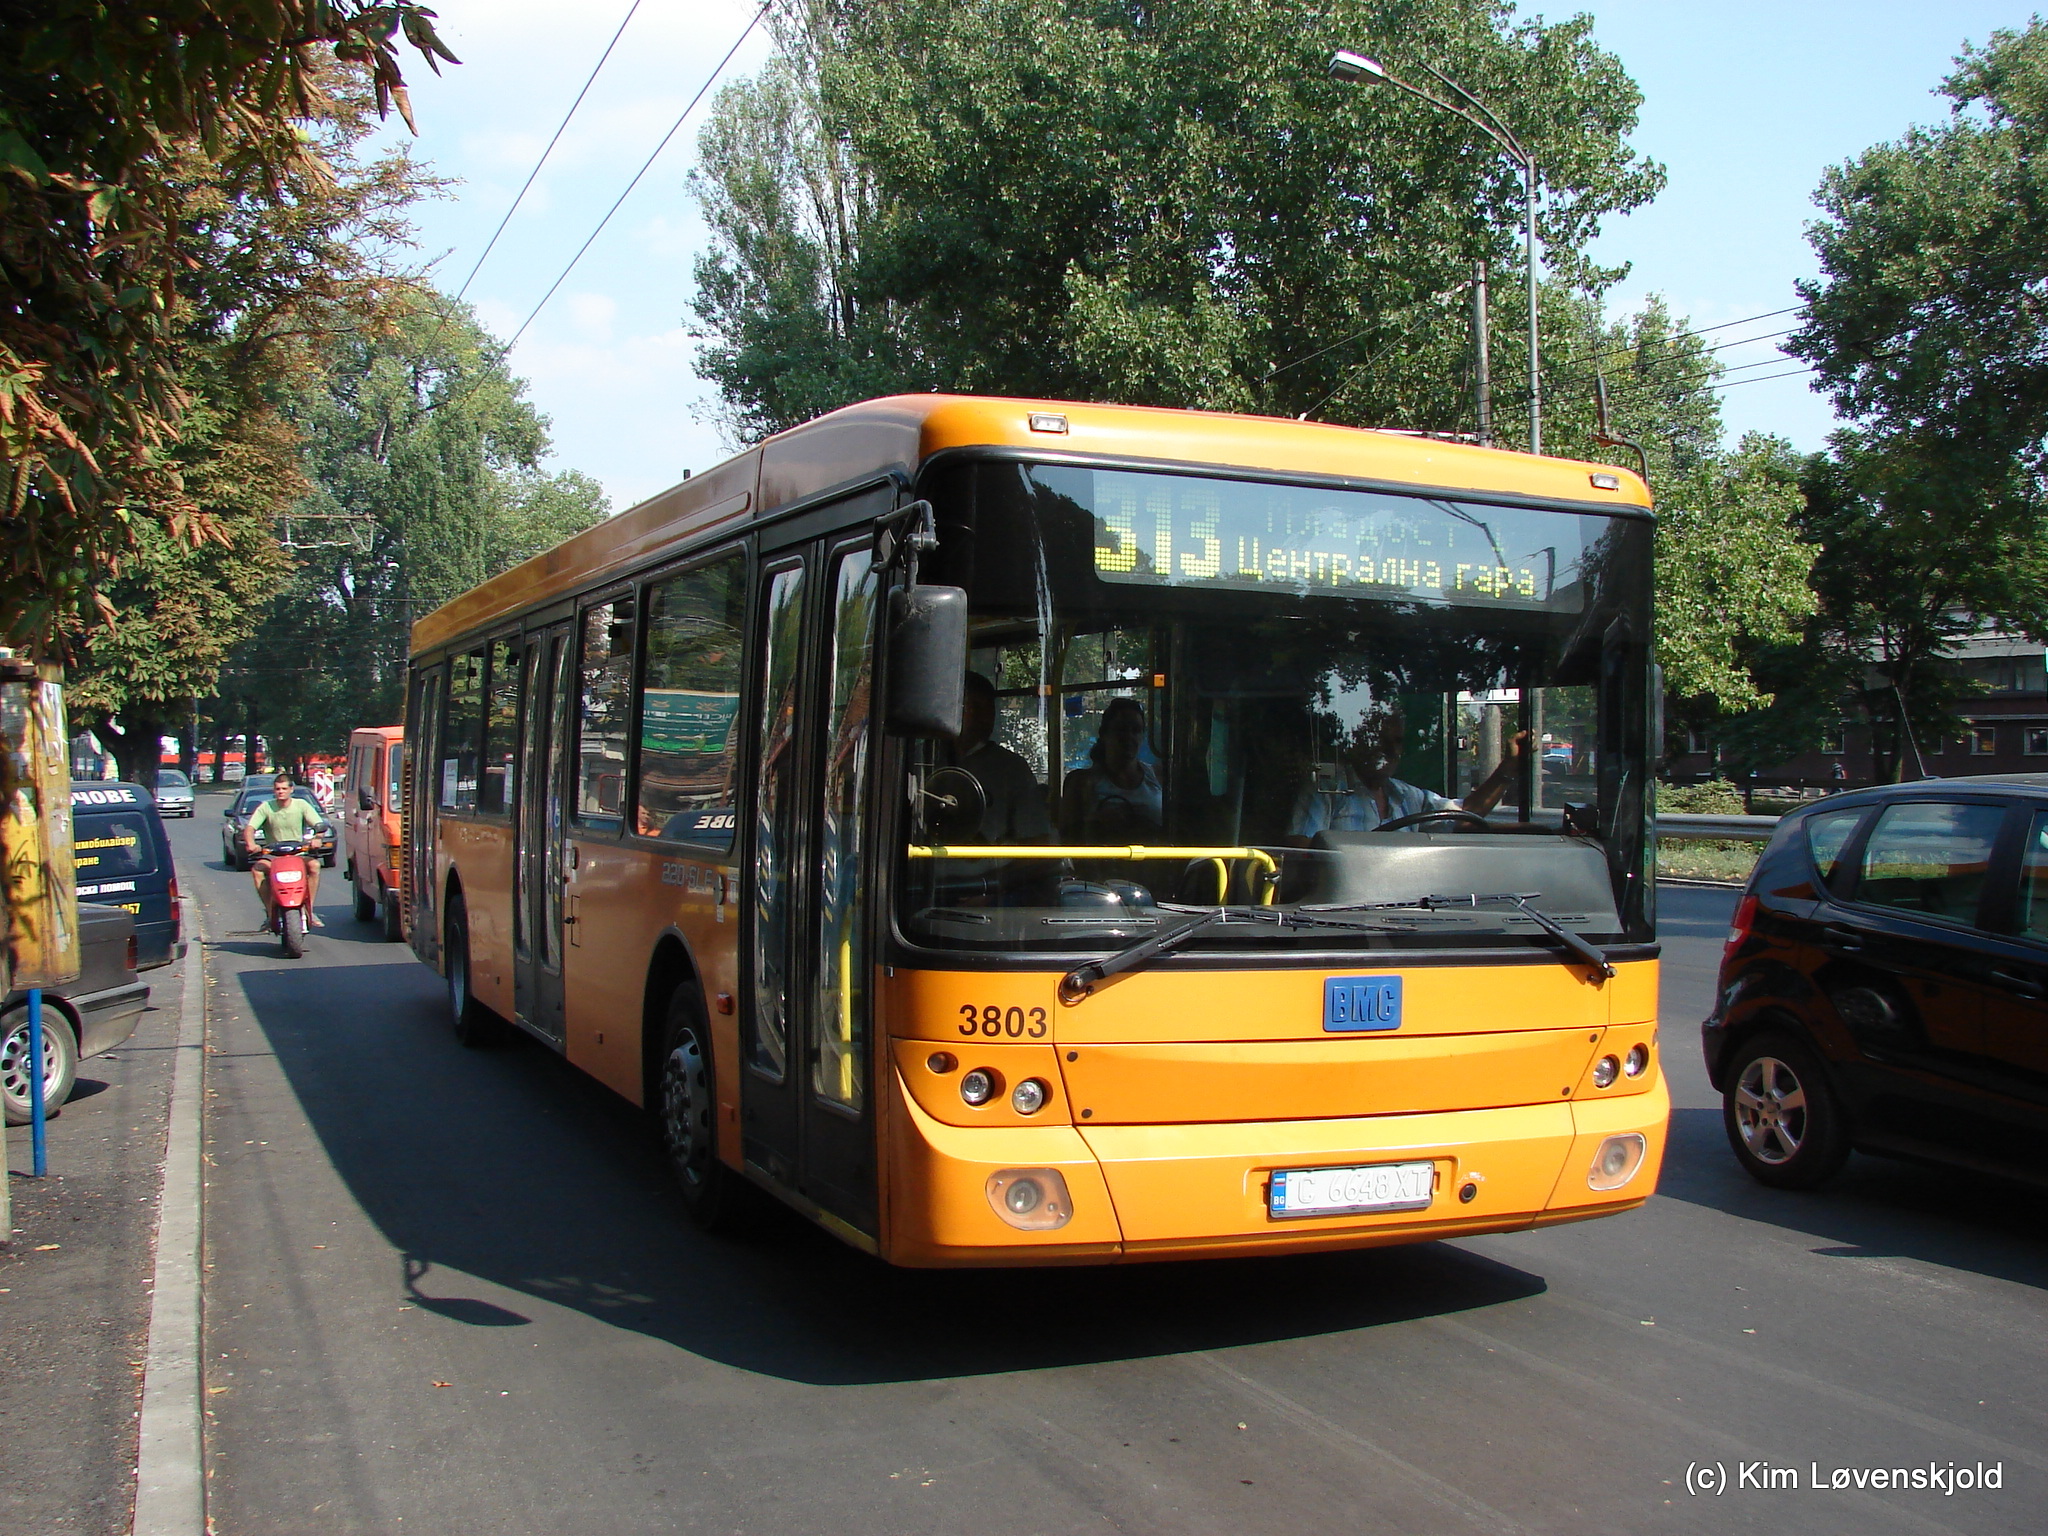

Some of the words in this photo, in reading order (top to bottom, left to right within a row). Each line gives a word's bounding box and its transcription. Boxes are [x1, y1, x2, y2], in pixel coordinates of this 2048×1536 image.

[1095, 482, 1221, 577] 313
[1239, 535, 1441, 588] Централна
[1456, 563, 1535, 598] гара
[958, 1004, 1047, 1037] 3803
[1332, 983, 1395, 1023] BMC
[1273, 1195, 1285, 1206] BG
